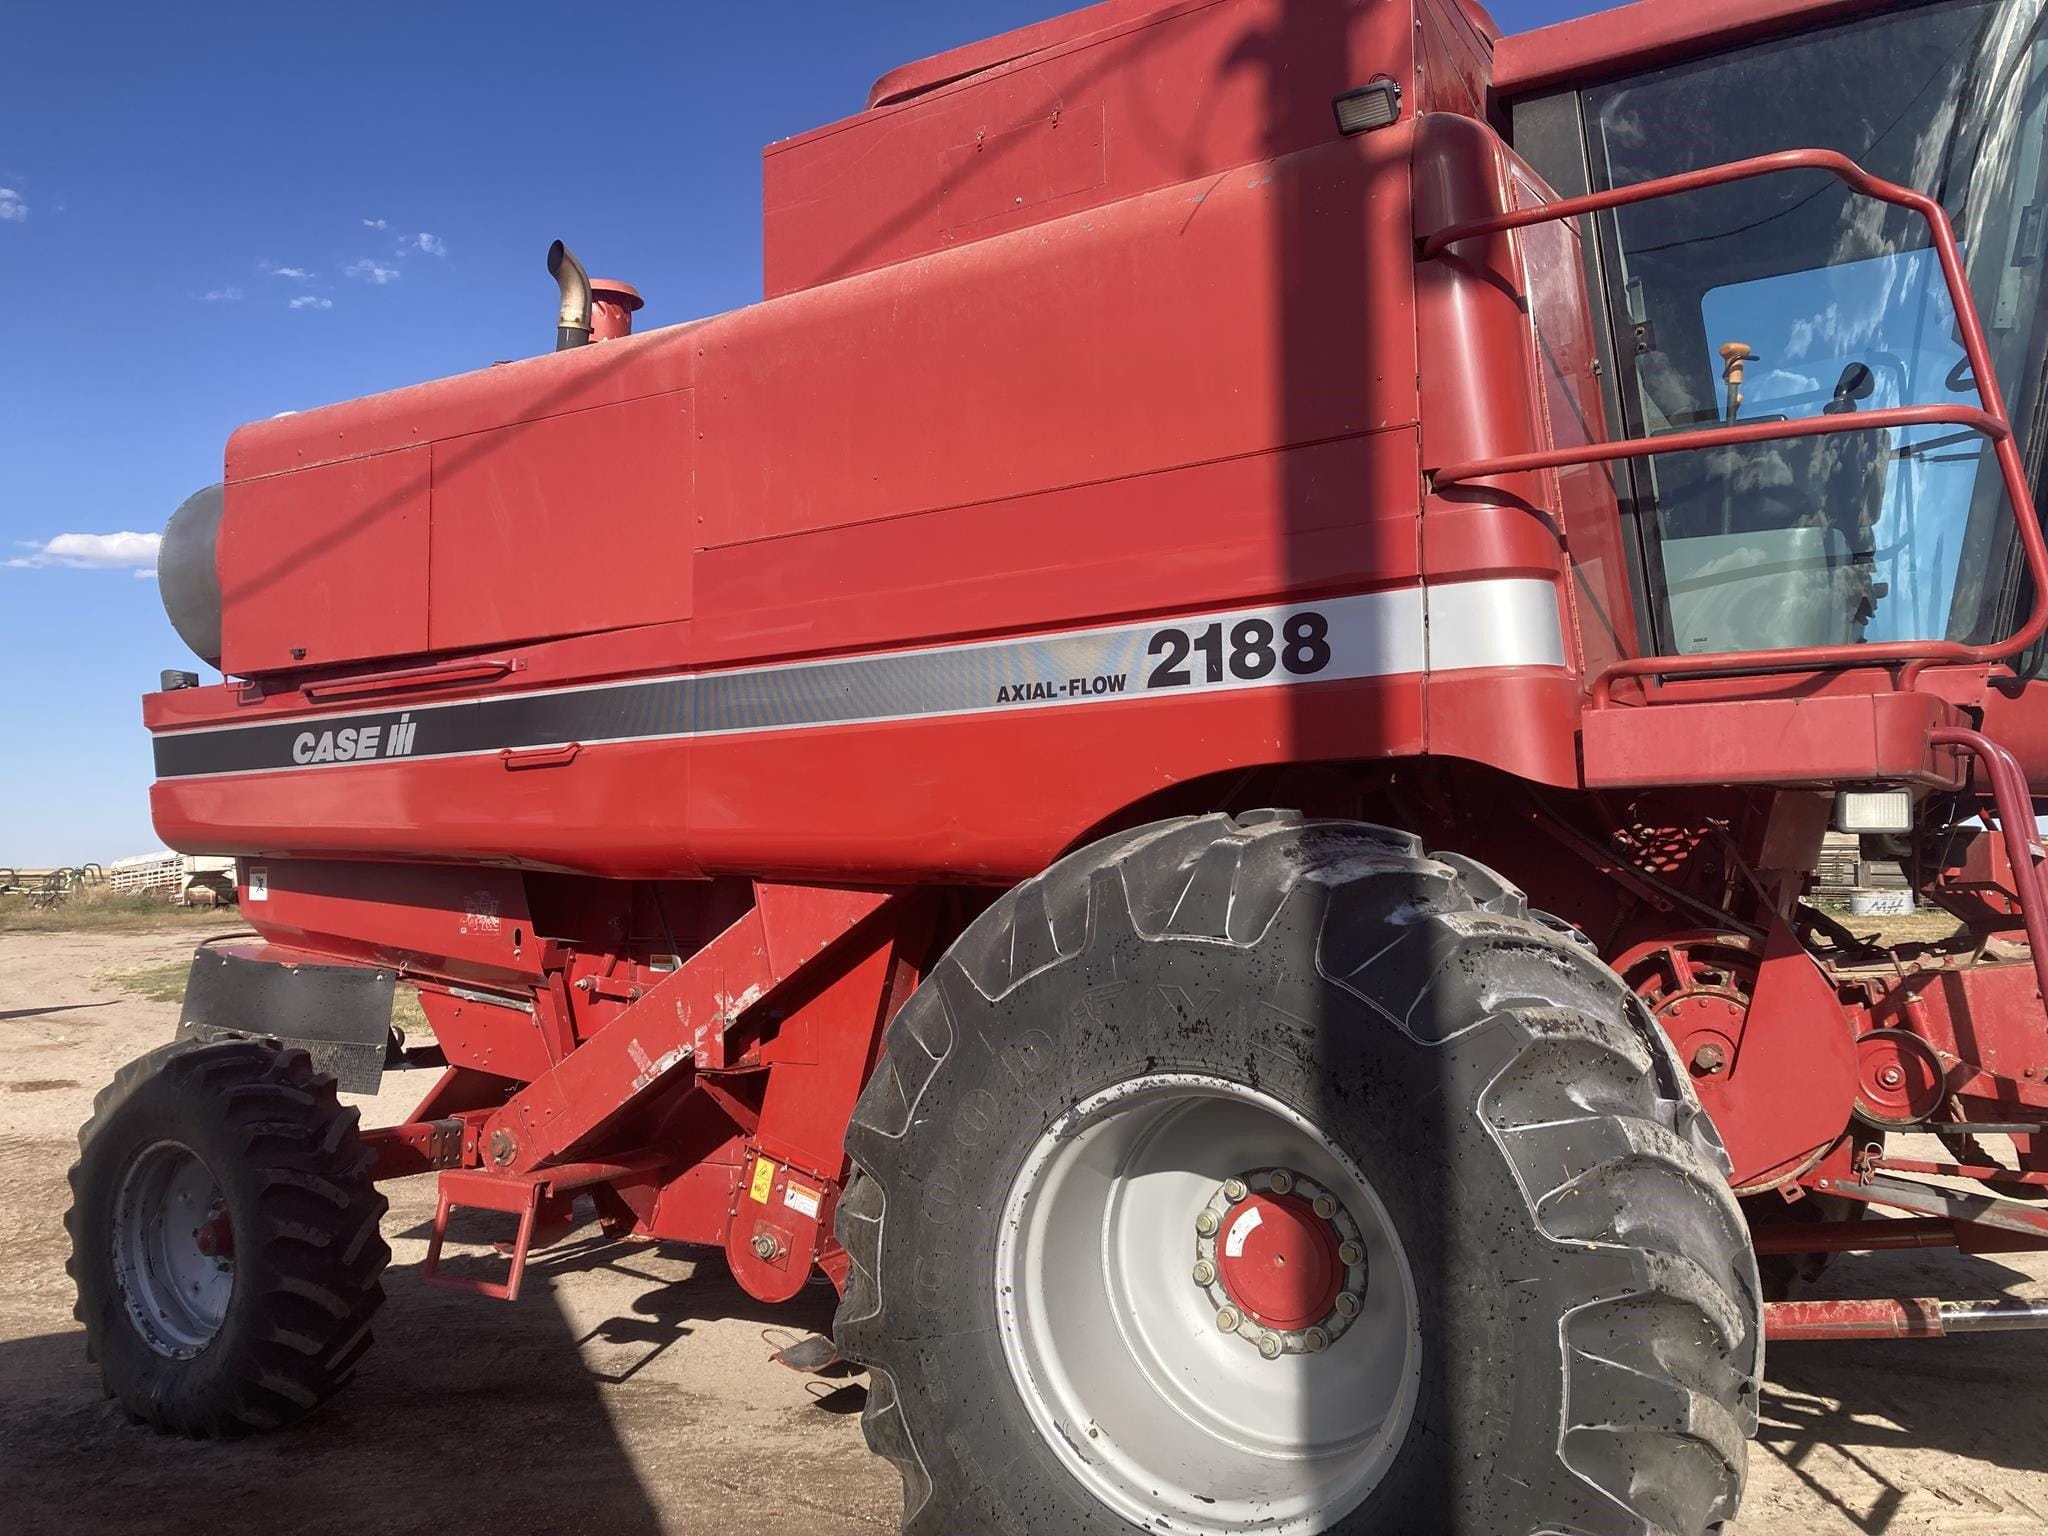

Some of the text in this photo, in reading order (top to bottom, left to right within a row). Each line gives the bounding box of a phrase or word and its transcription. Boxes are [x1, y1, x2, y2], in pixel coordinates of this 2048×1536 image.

[997, 612, 1332, 703] AXIAL-FLOW 2188
[292, 726, 382, 764] CASE
